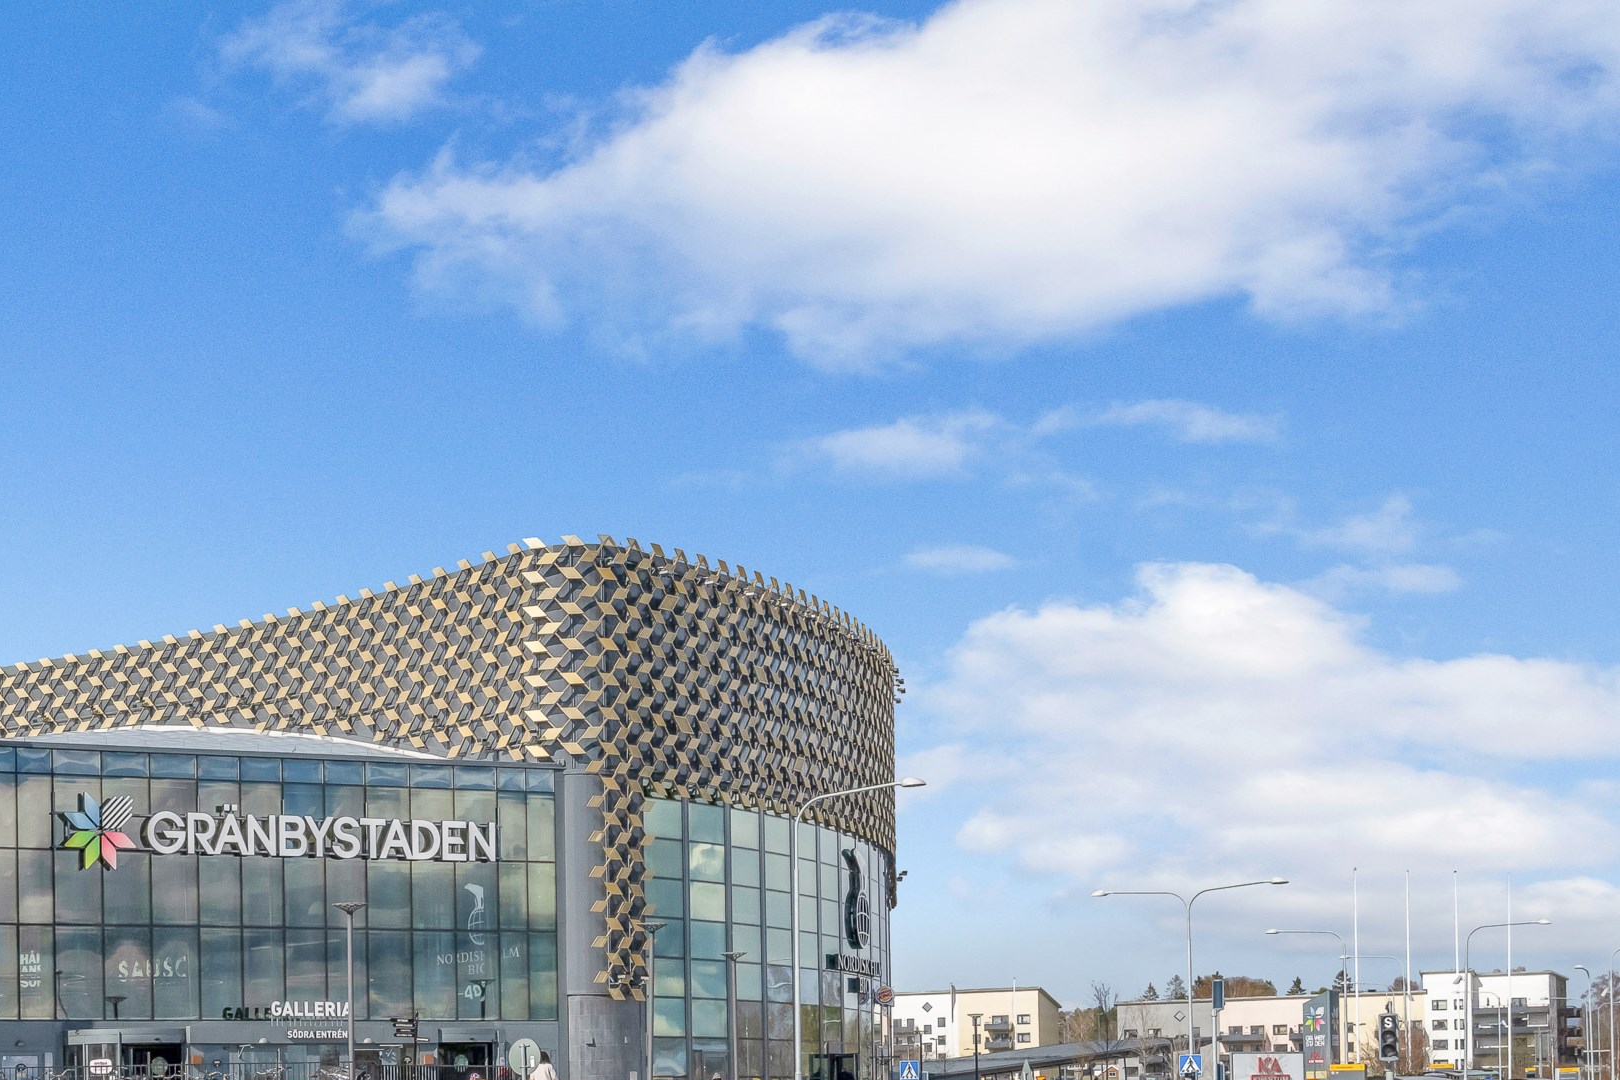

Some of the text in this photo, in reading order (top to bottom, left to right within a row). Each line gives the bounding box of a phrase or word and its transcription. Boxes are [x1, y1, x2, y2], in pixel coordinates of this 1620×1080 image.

[147, 804, 496, 862] GRÄNBYSTADEN
[839, 953, 870, 974] NORDISK
[271, 1001, 349, 1017] GALLERIA
[287, 1029, 348, 1039] SÖDRA ENTRÉN
[1258, 1056, 1283, 1073] ICA
